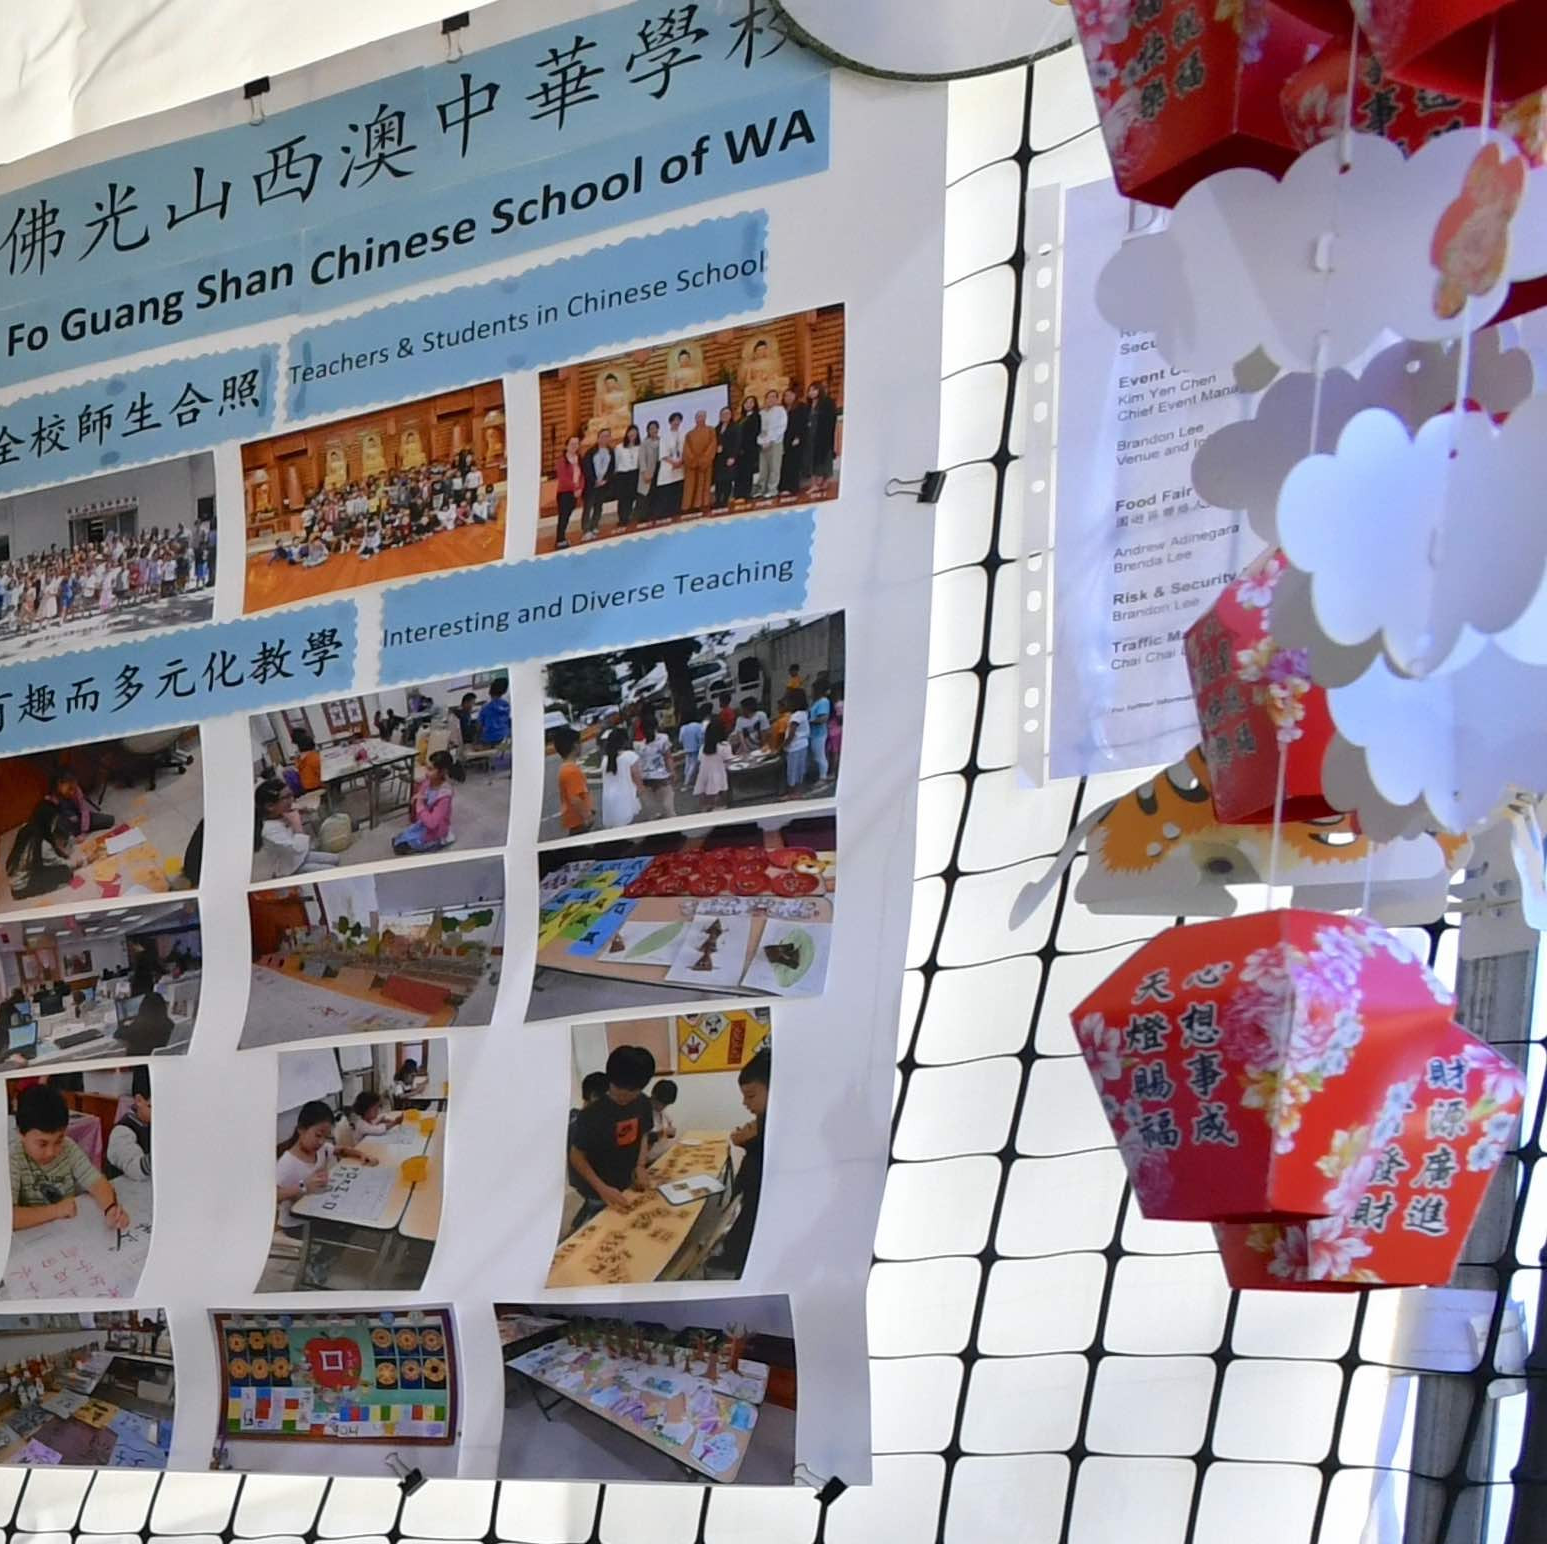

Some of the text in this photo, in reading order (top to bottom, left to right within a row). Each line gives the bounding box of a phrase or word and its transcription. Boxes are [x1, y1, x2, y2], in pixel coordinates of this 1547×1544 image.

[7, 108, 816, 357] Fo Guang Shan Chinese School of WA
[289, 250, 766, 386] Teachers & Students in Chinese School
[1118, 375, 1217, 406] Kim Yen Chen
[1119, 369, 1165, 388] Event
[1117, 406, 1154, 422] Chief
[1158, 396, 1197, 413] Event
[1117, 430, 1175, 451] Brandon
[1179, 424, 1204, 438] Lee
[1116, 449, 1160, 466] Venue
[1115, 486, 1193, 512] Food Fair
[383, 557, 795, 649] Interesting and Diverse Teaching
[1113, 571, 1237, 606] Risk & Security
[1111, 636, 1162, 653] Traffic
[1125, 968, 1180, 1150] 天燈賜福
[1181, 961, 1238, 1148] 心想事成
[1405, 1056, 1468, 1235] 財源廣進
